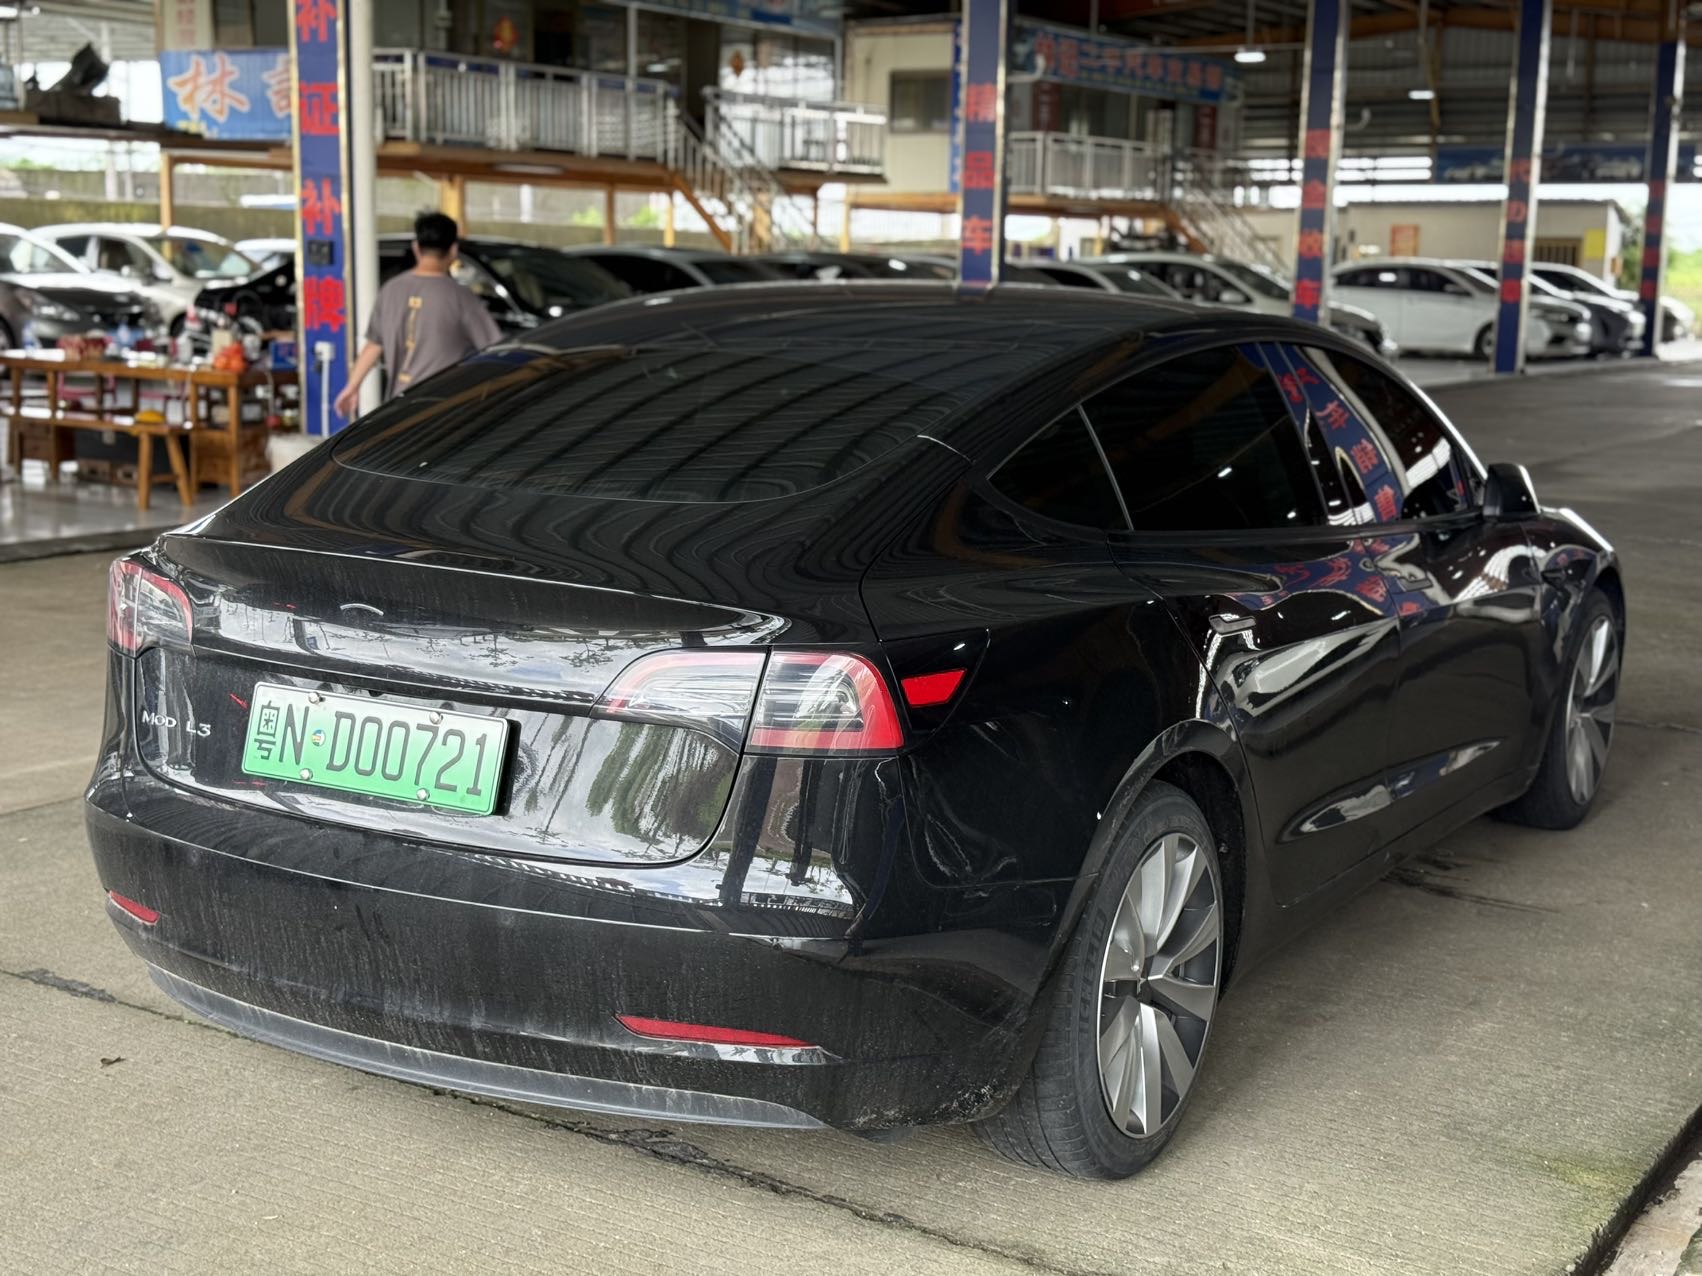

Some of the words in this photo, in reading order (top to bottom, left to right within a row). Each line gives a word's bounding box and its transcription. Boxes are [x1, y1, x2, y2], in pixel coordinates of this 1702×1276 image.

[961, 81, 998, 284] 精品车
[141, 710, 177, 728] MOD
